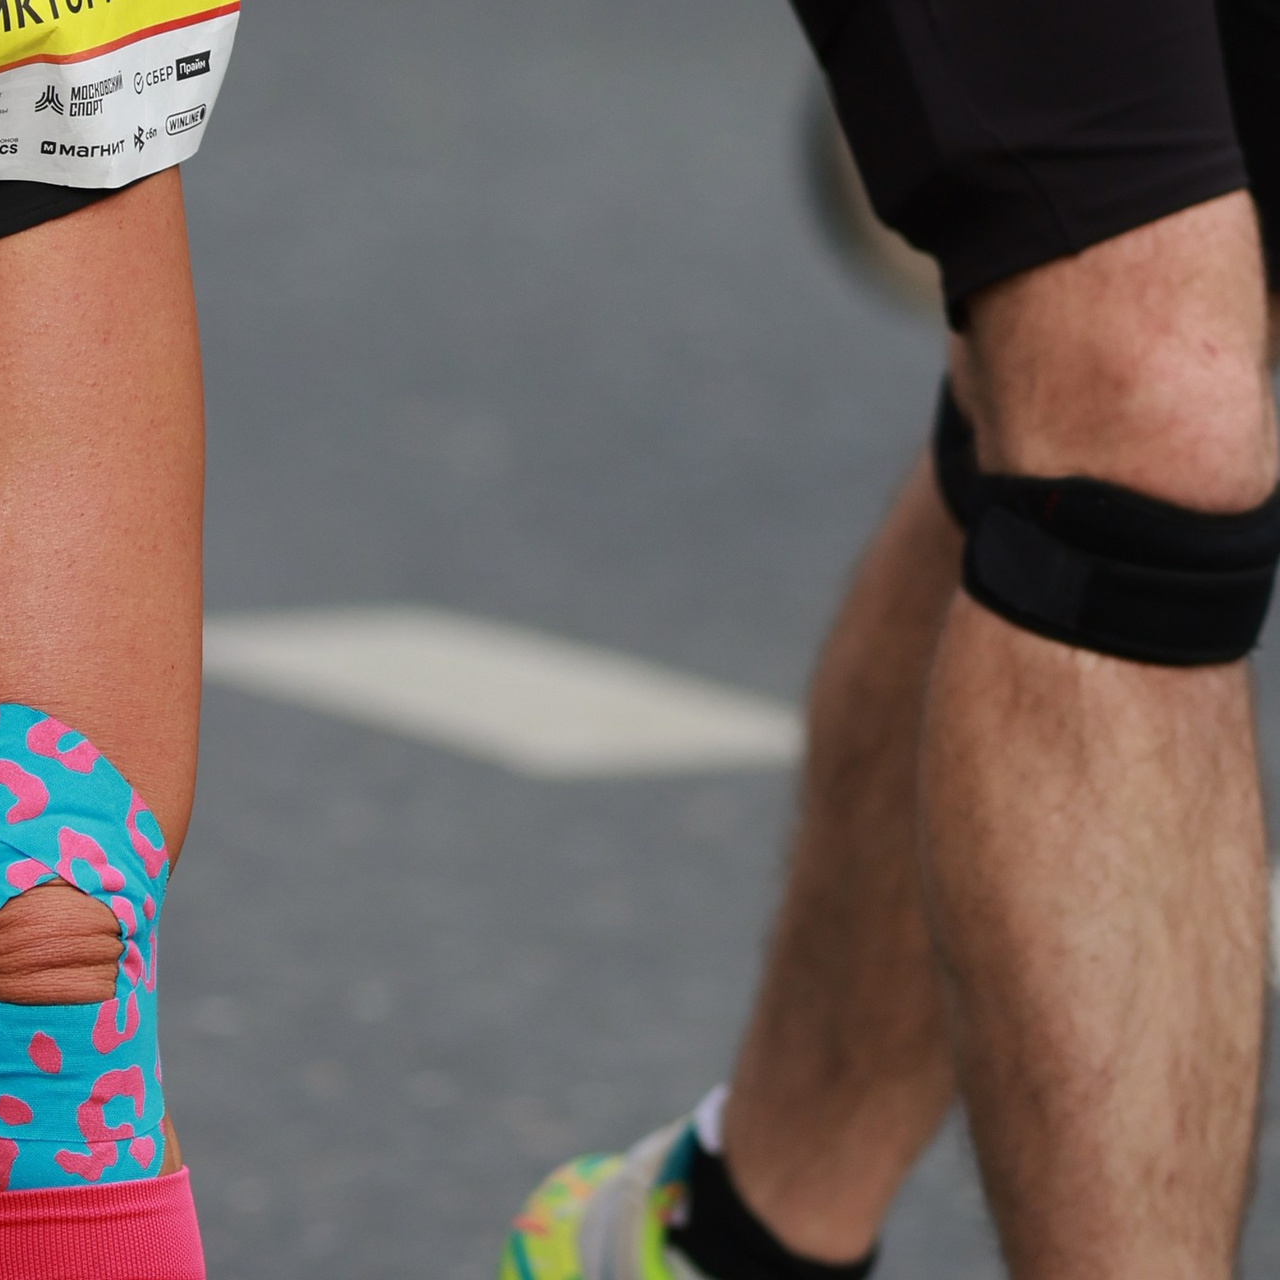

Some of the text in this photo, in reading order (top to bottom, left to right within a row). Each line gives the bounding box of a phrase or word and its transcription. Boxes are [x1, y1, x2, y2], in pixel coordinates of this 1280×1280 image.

[146, 58, 206, 87] СБЕР Прайм
[70, 70, 123, 101] МОСКОВСКИЙ
[69, 98, 104, 117] СПОРТ
[169, 110, 200, 131] WINLINE
